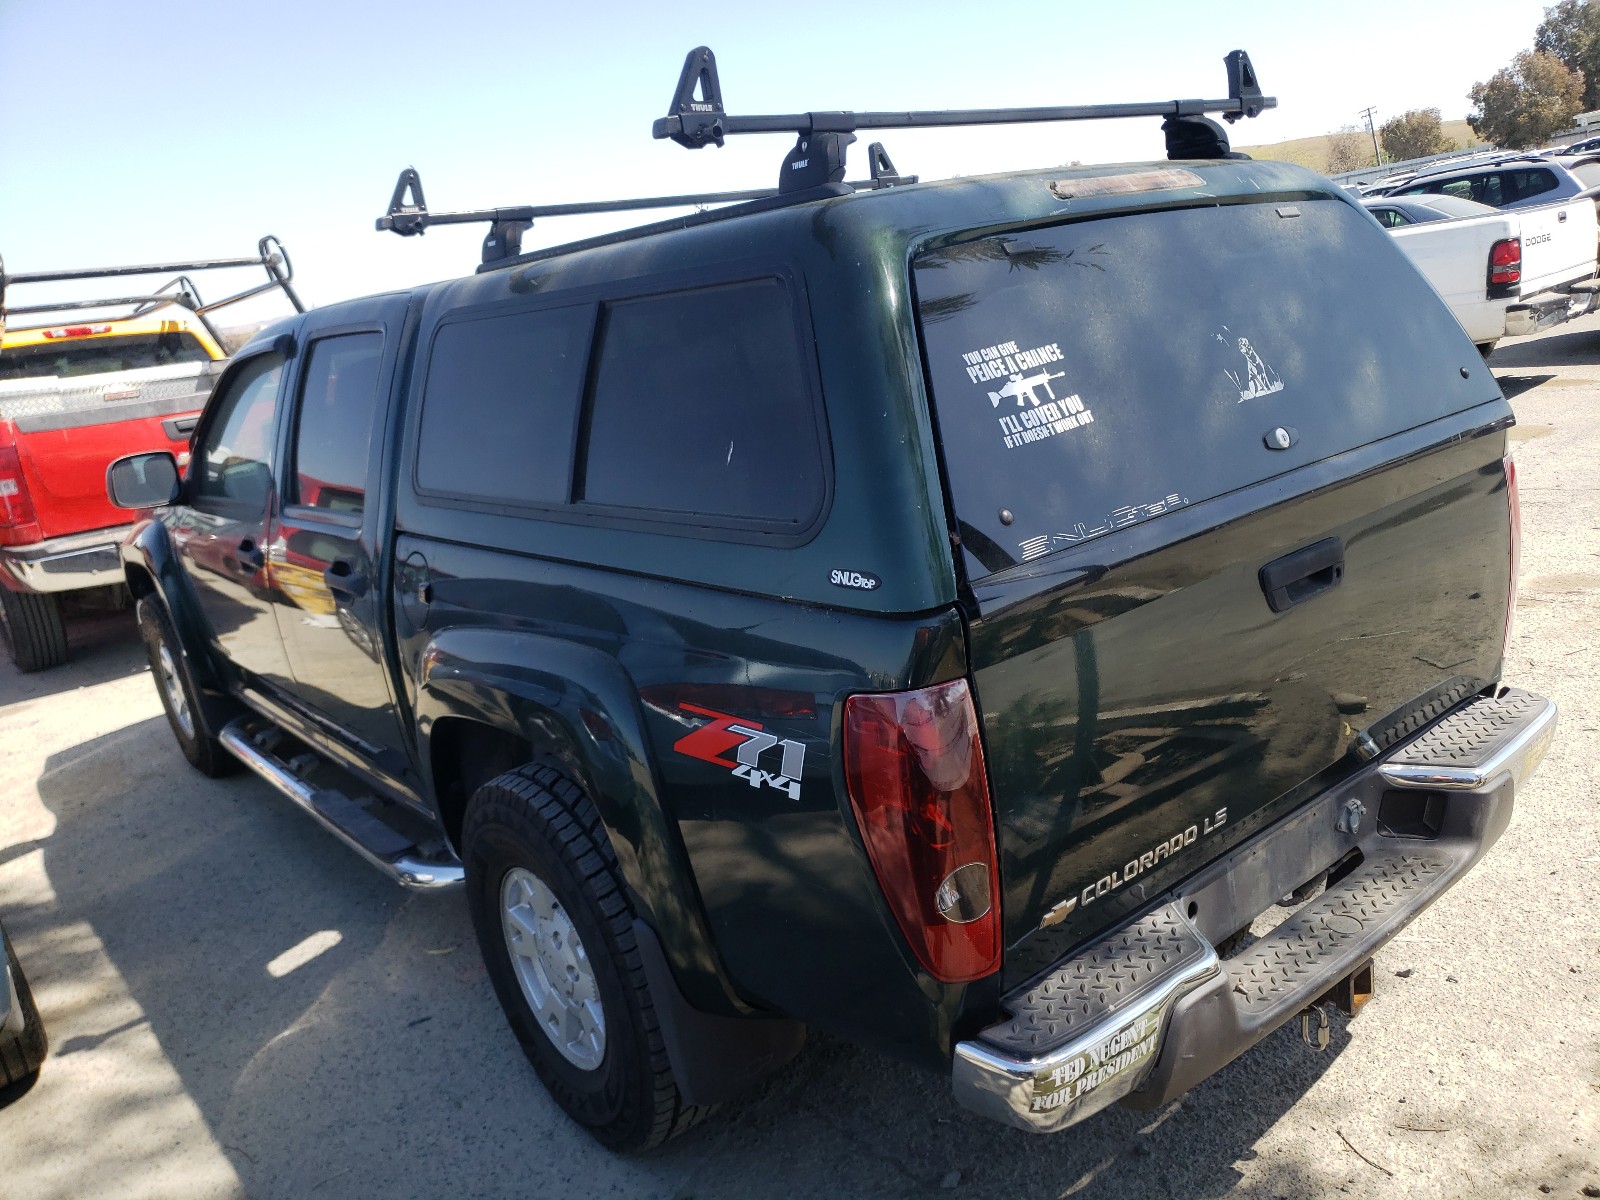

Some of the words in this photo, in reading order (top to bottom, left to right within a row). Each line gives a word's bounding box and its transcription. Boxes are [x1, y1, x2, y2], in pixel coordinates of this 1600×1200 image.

[691, 103, 713, 112] THULE
[792, 159, 809, 170] THULE
[1525, 233, 1552, 247] DODGE
[962, 350, 983, 366] YOU
[980, 345, 1001, 362] CAN
[998, 340, 1020, 355] GIVE
[966, 356, 1009, 384] PEACE
[1005, 356, 1019, 374] A
[1015, 343, 1064, 370] CHANCE
[999, 414, 1023, 436] I'LL
[1020, 402, 1062, 429] COVER
[1057, 394, 1085, 417] YOU
[1003, 435, 1013, 449] IF
[1011, 433, 1023, 447] IT
[1053, 416, 1080, 434] WORK
[1076, 410, 1095, 426] OUT
[673, 702, 806, 781] Z71
[1081, 825, 1198, 907] COLORADO
[1203, 807, 1228, 836] LS
[1032, 1087, 1072, 1111] FOR
[1075, 1034, 1158, 1095] PRESIDENT
[1052, 1056, 1086, 1088] TED
[1085, 1018, 1149, 1070] NUGENT
